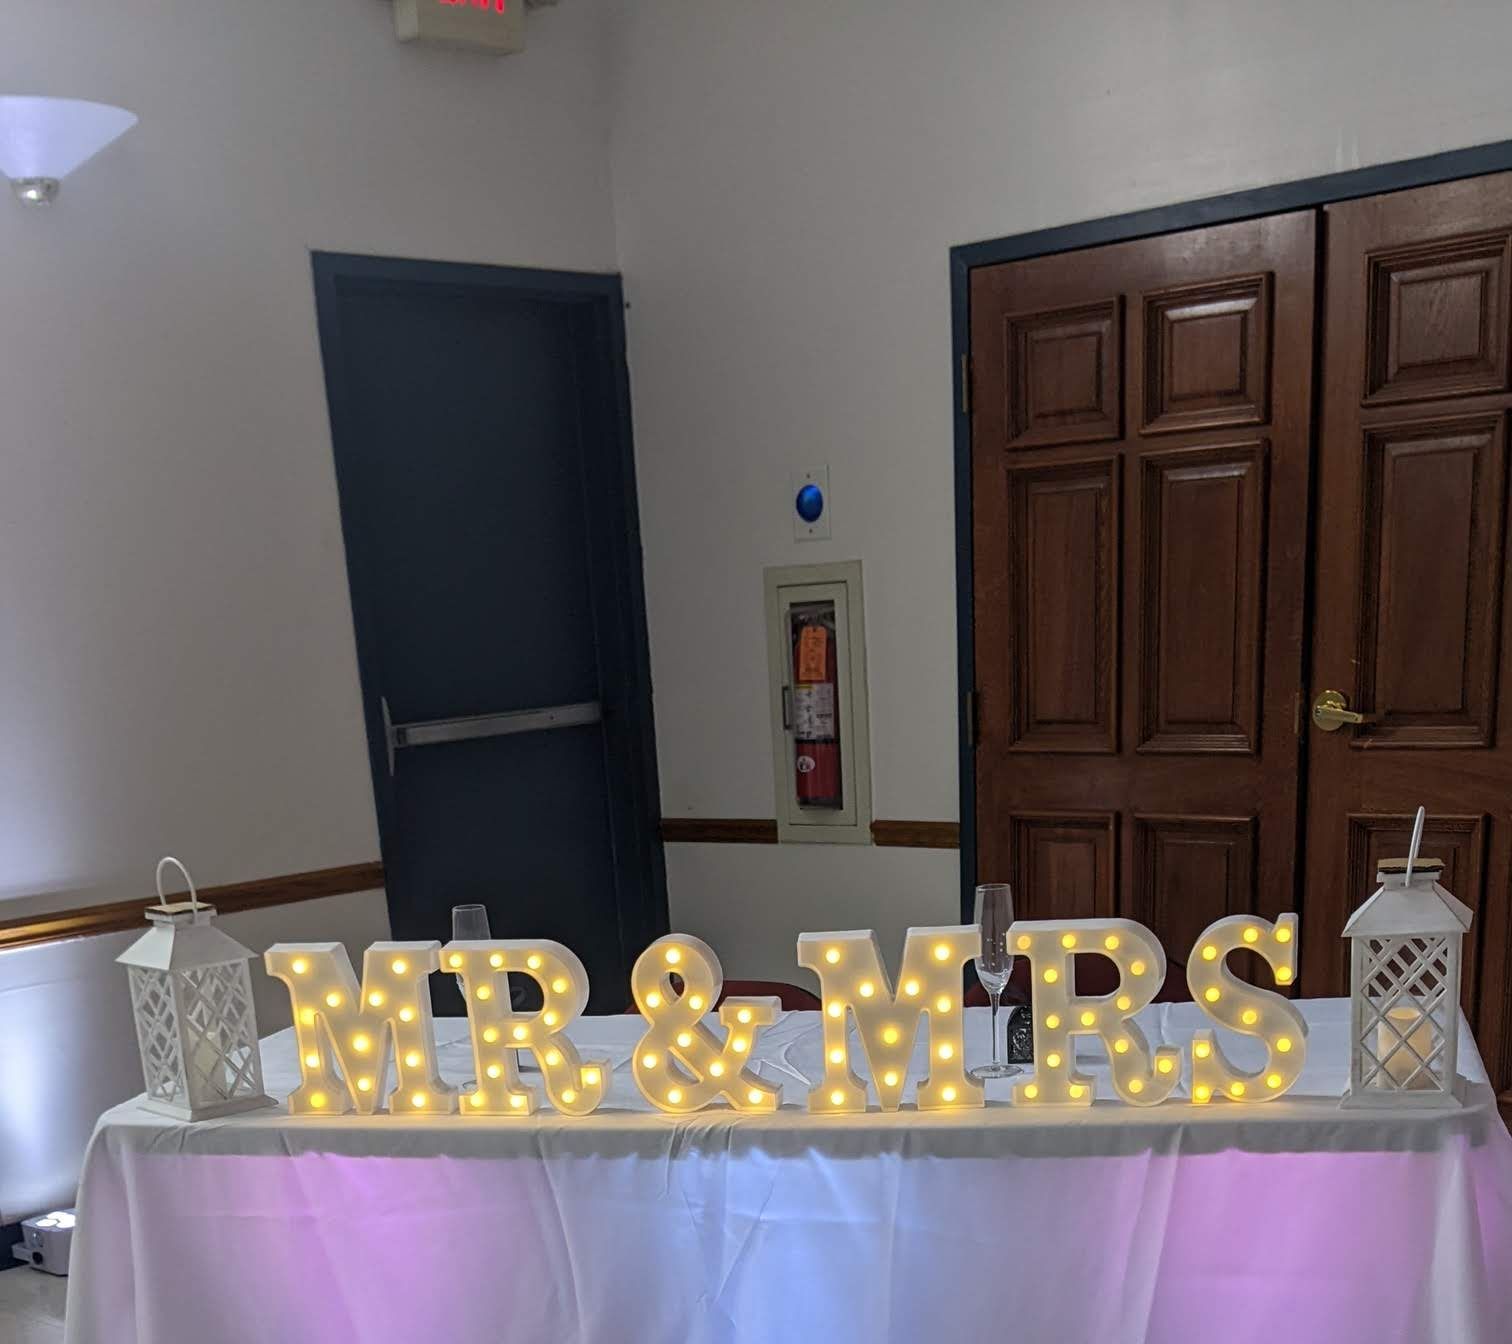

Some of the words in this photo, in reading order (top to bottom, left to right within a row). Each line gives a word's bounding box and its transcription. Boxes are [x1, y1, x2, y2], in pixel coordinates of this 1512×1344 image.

[264, 939, 609, 1117] MR
[631, 932, 783, 1114] &
[797, 911, 1310, 1114] MRS
